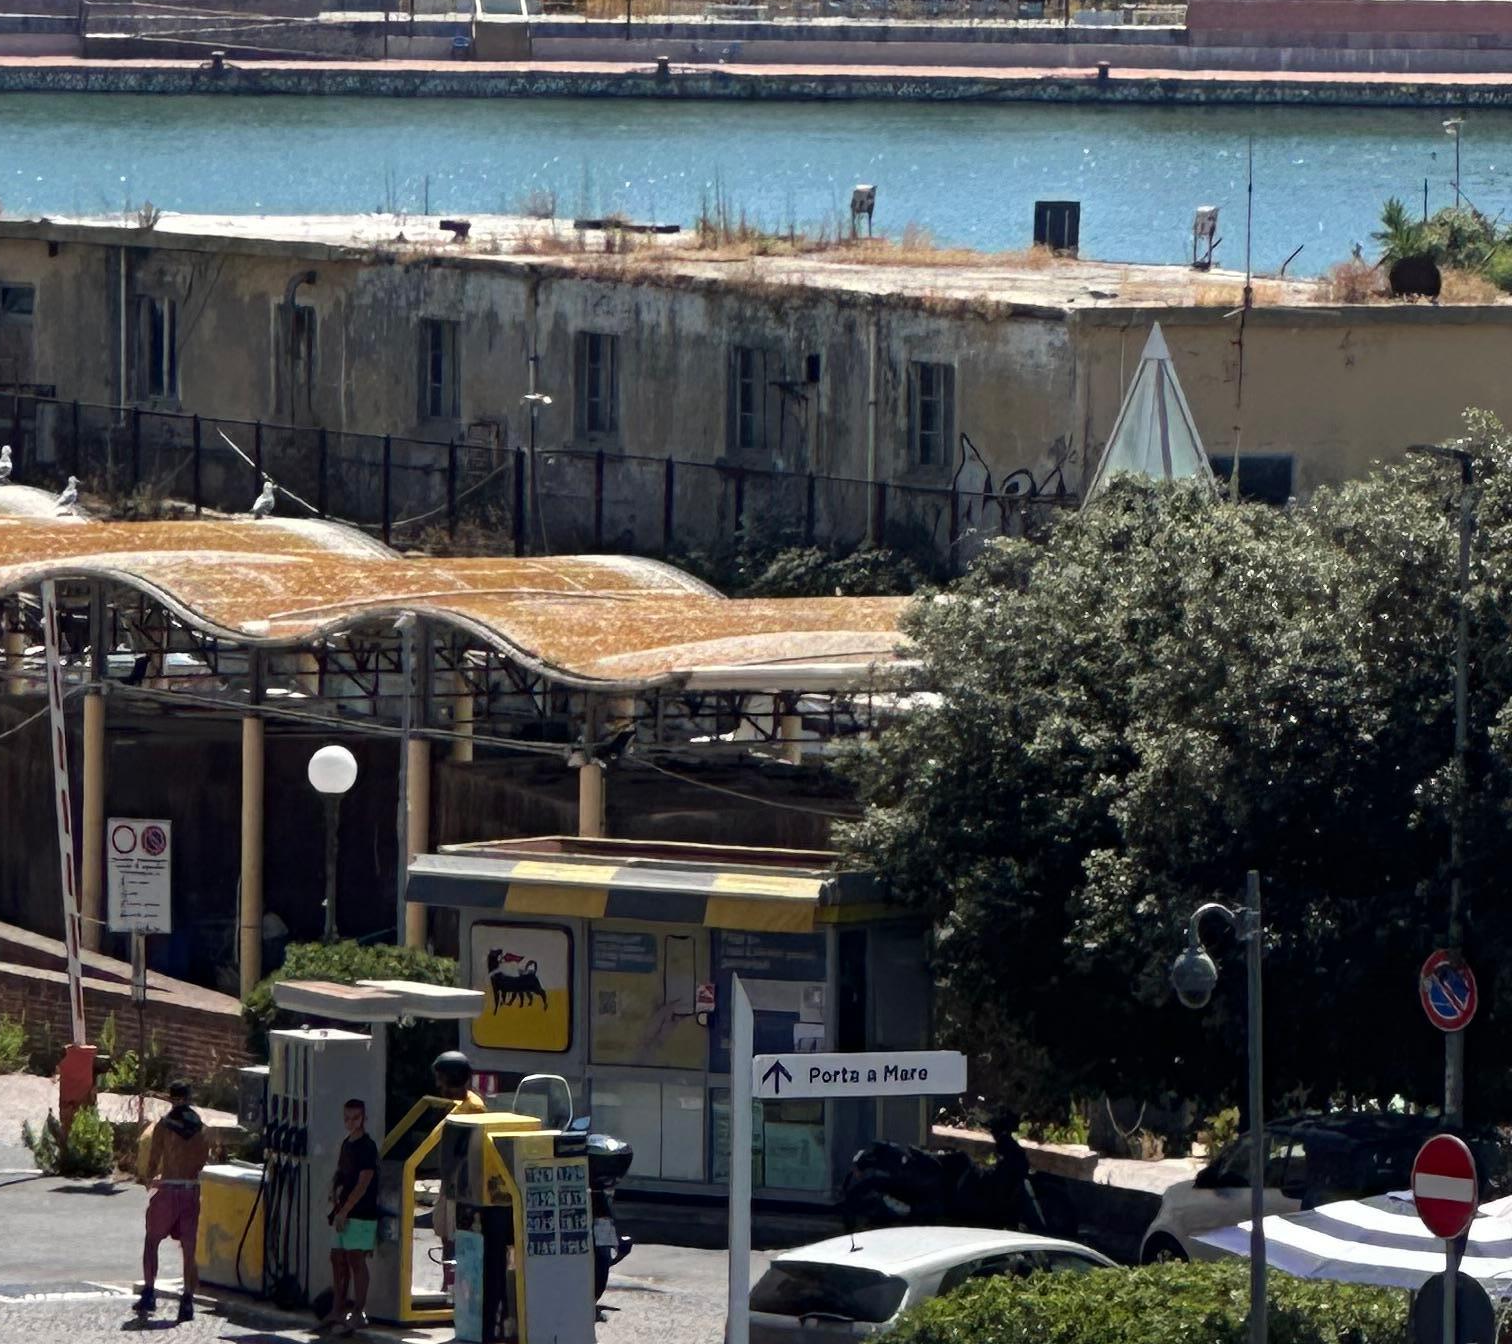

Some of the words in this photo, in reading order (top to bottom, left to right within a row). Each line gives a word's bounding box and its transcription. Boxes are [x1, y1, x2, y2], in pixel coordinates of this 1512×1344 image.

[809, 1067, 860, 1083] Porta
[867, 1070, 877, 1082] a
[883, 1064, 929, 1083] Mare
